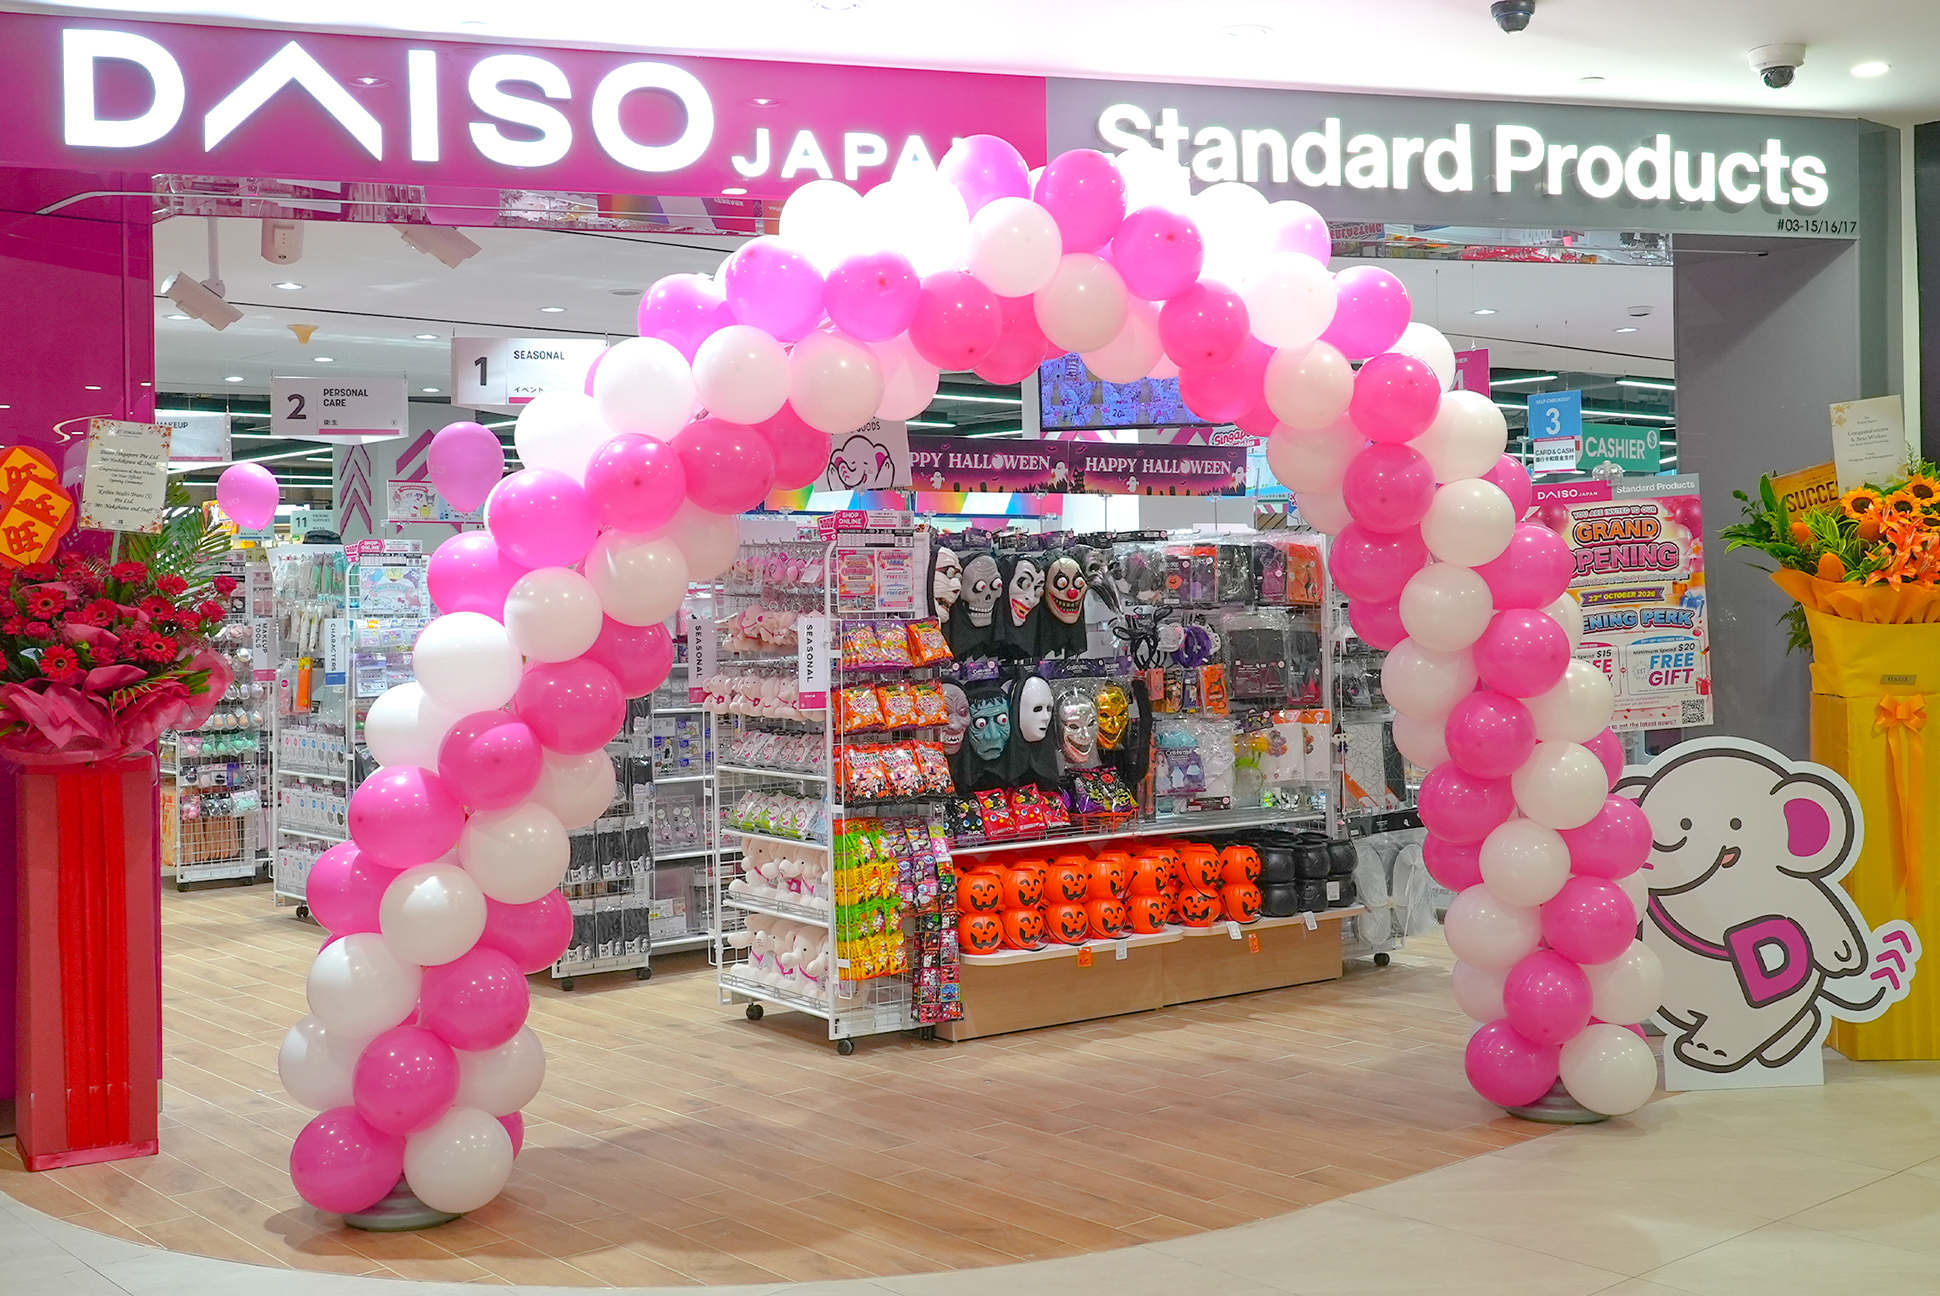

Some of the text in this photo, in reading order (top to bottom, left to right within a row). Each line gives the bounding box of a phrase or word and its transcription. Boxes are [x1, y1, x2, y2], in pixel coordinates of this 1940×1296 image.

[62, 28, 966, 181] DAISO JAPA
[1099, 103, 1829, 206] Standard Products
[1777, 219, 1857, 234] #03-15/16/17
[474, 350, 565, 386] 1 SEASONAL
[286, 388, 368, 420] 2 PERSONAL
[323, 398, 346, 407] CARE
[1545, 407, 1561, 435] 3
[1585, 436, 1646, 459] CASHIER
[909, 452, 1051, 471] PPY HALLOWEEN
[1085, 456, 1232, 475] HAPPY HALLOWEEN
[1537, 489, 1578, 500] DAISO
[1616, 480, 1695, 494] Standard Products
[1786, 480, 1838, 513] SUCCE
[842, 511, 859, 519] SHOP
[1574, 505, 1656, 519] YOU ARE INVITED TO OUR
[296, 516, 307, 528] 11
[1576, 519, 1659, 543] GRAND
[2, 520, 43, 555] 旺
[1571, 549, 1678, 574] PENING
[1603, 592, 1637, 600] OCTOBER
[1583, 608, 1694, 631] ENING PERK
[695, 625, 703, 680] SEASONAL
[806, 624, 814, 684] SEASONAL
[1596, 650, 1612, 658] $15
[1633, 648, 1659, 656] Minimum
[1679, 643, 1696, 652] $20
[1650, 653, 1695, 670] FREE
[1649, 668, 1695, 687] GIFT
[1640, 720, 1657, 728] latest
